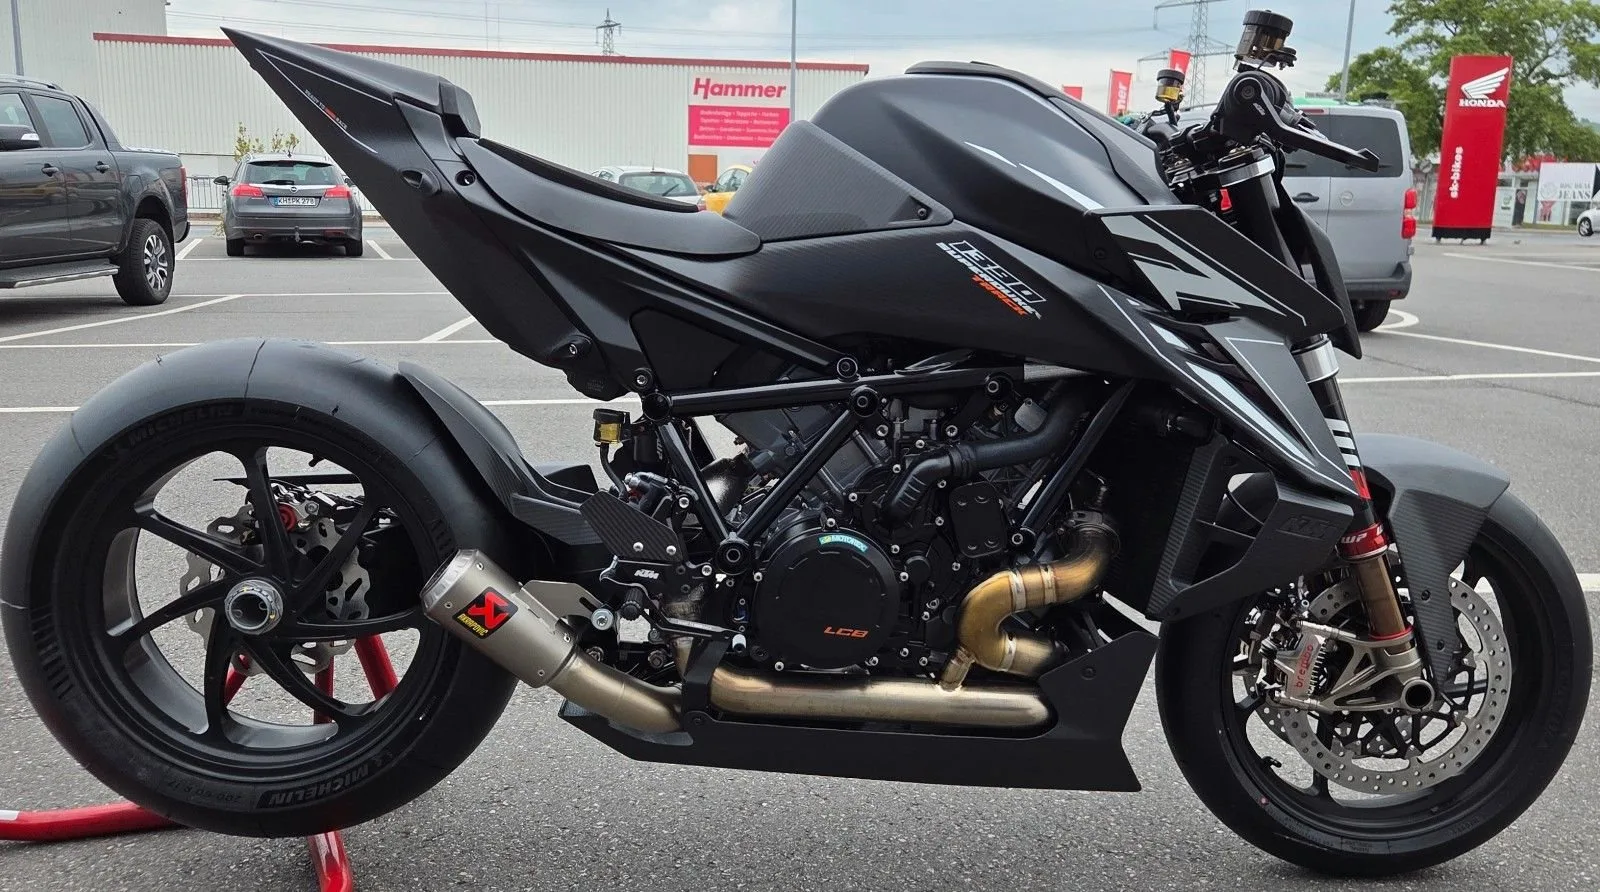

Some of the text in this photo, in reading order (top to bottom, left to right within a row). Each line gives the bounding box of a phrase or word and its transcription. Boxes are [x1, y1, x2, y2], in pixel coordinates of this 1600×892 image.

[693, 77, 787, 100] Hammer
[1459, 98, 1507, 109] HONDA
[1449, 146, 1464, 199] sk-bikes
[972, 274, 1029, 316] TRACK
[832, 534, 868, 553] MOTOREX
[1341, 532, 1368, 545] WP
[634, 569, 660, 580] KTM
[823, 626, 869, 639] LC8
[1295, 644, 1314, 689] brembo
[268, 766, 369, 806] MICHELIN
